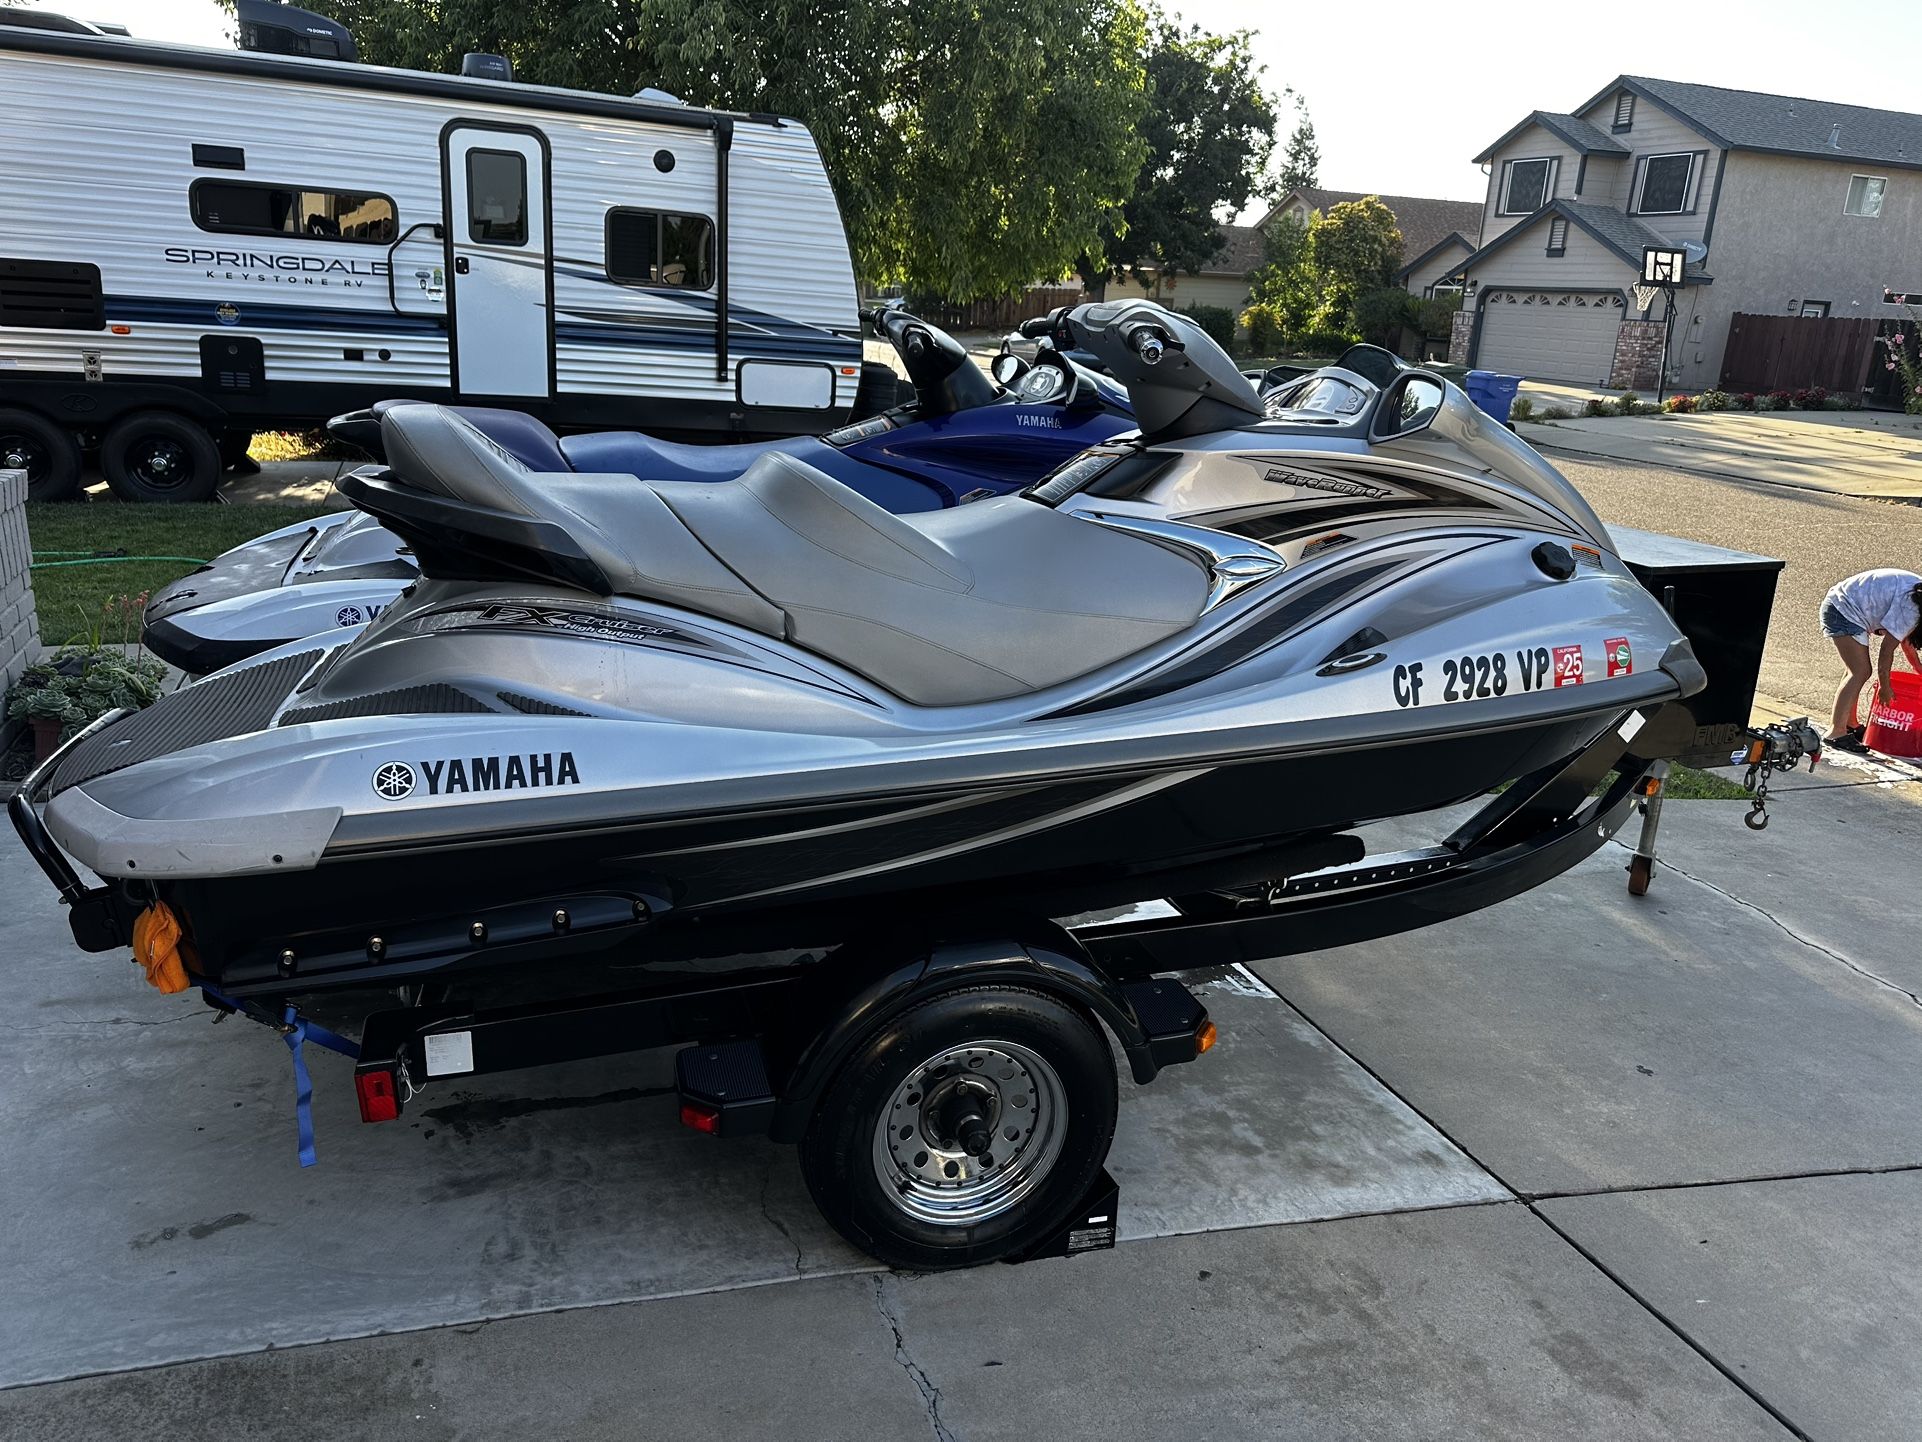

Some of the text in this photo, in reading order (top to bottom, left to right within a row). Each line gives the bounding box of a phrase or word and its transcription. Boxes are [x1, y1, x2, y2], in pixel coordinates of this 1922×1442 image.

[164, 247, 390, 277] SPRINGDALE
[206, 270, 364, 288] KEYSTONE RV
[1015, 414, 1063, 430] YAMAHA
[477, 603, 572, 627] FX
[563, 623, 645, 640] High Output
[1563, 652, 1583, 677] 25
[1392, 647, 1550, 708] CF 2928 VP
[1871, 703, 1915, 722] HARBOR
[420, 752, 580, 795] YAMAHA
